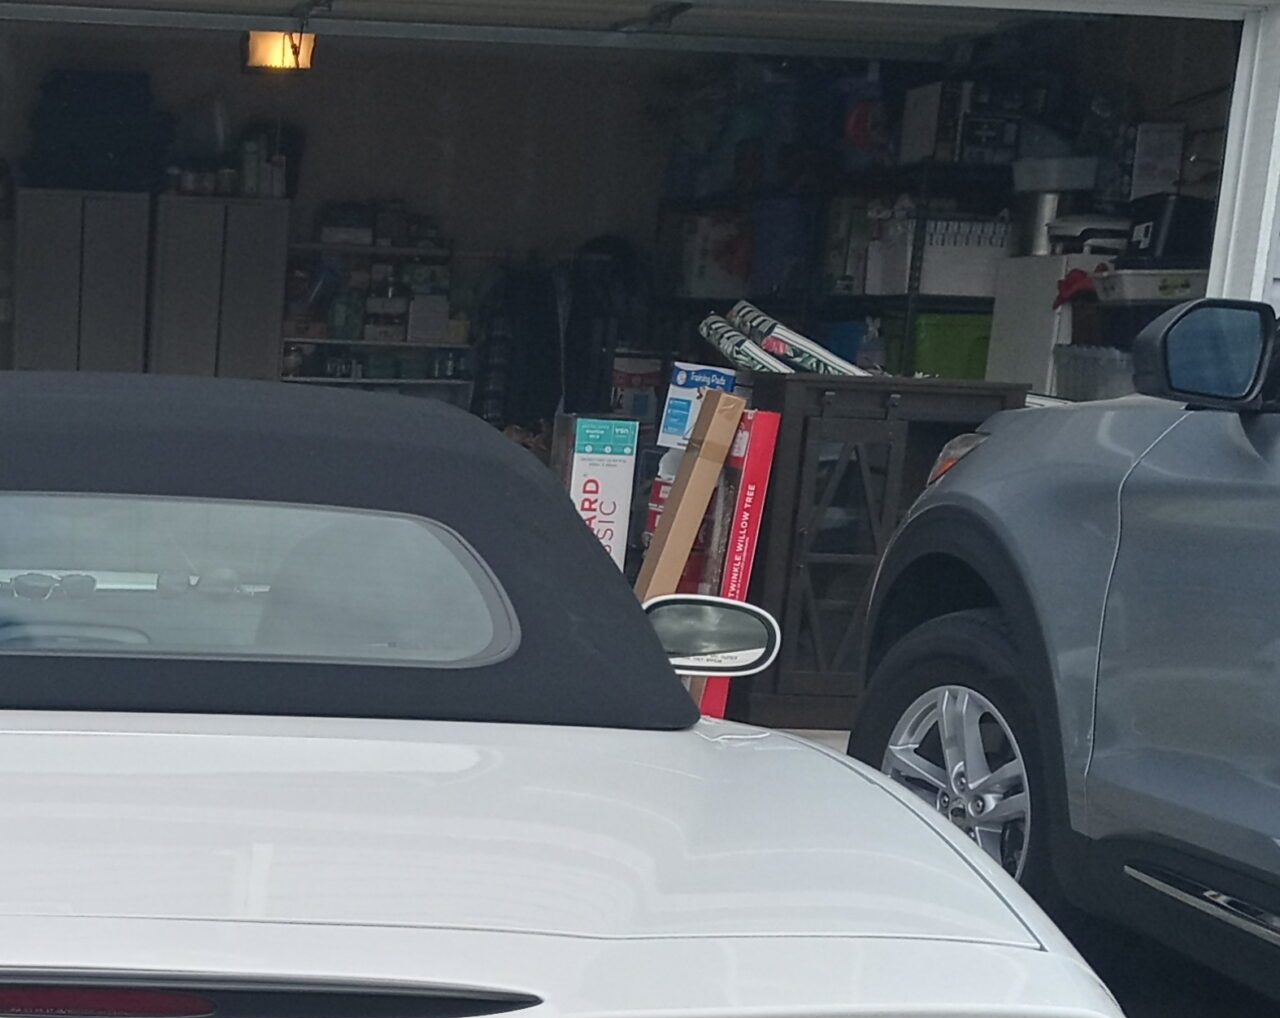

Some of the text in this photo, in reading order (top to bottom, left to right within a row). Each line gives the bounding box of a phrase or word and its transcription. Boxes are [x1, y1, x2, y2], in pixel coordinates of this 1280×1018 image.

[728, 554, 742, 598] TWINKLE
[736, 510, 750, 552] WILLOW
[744, 484, 756, 509] TREE
